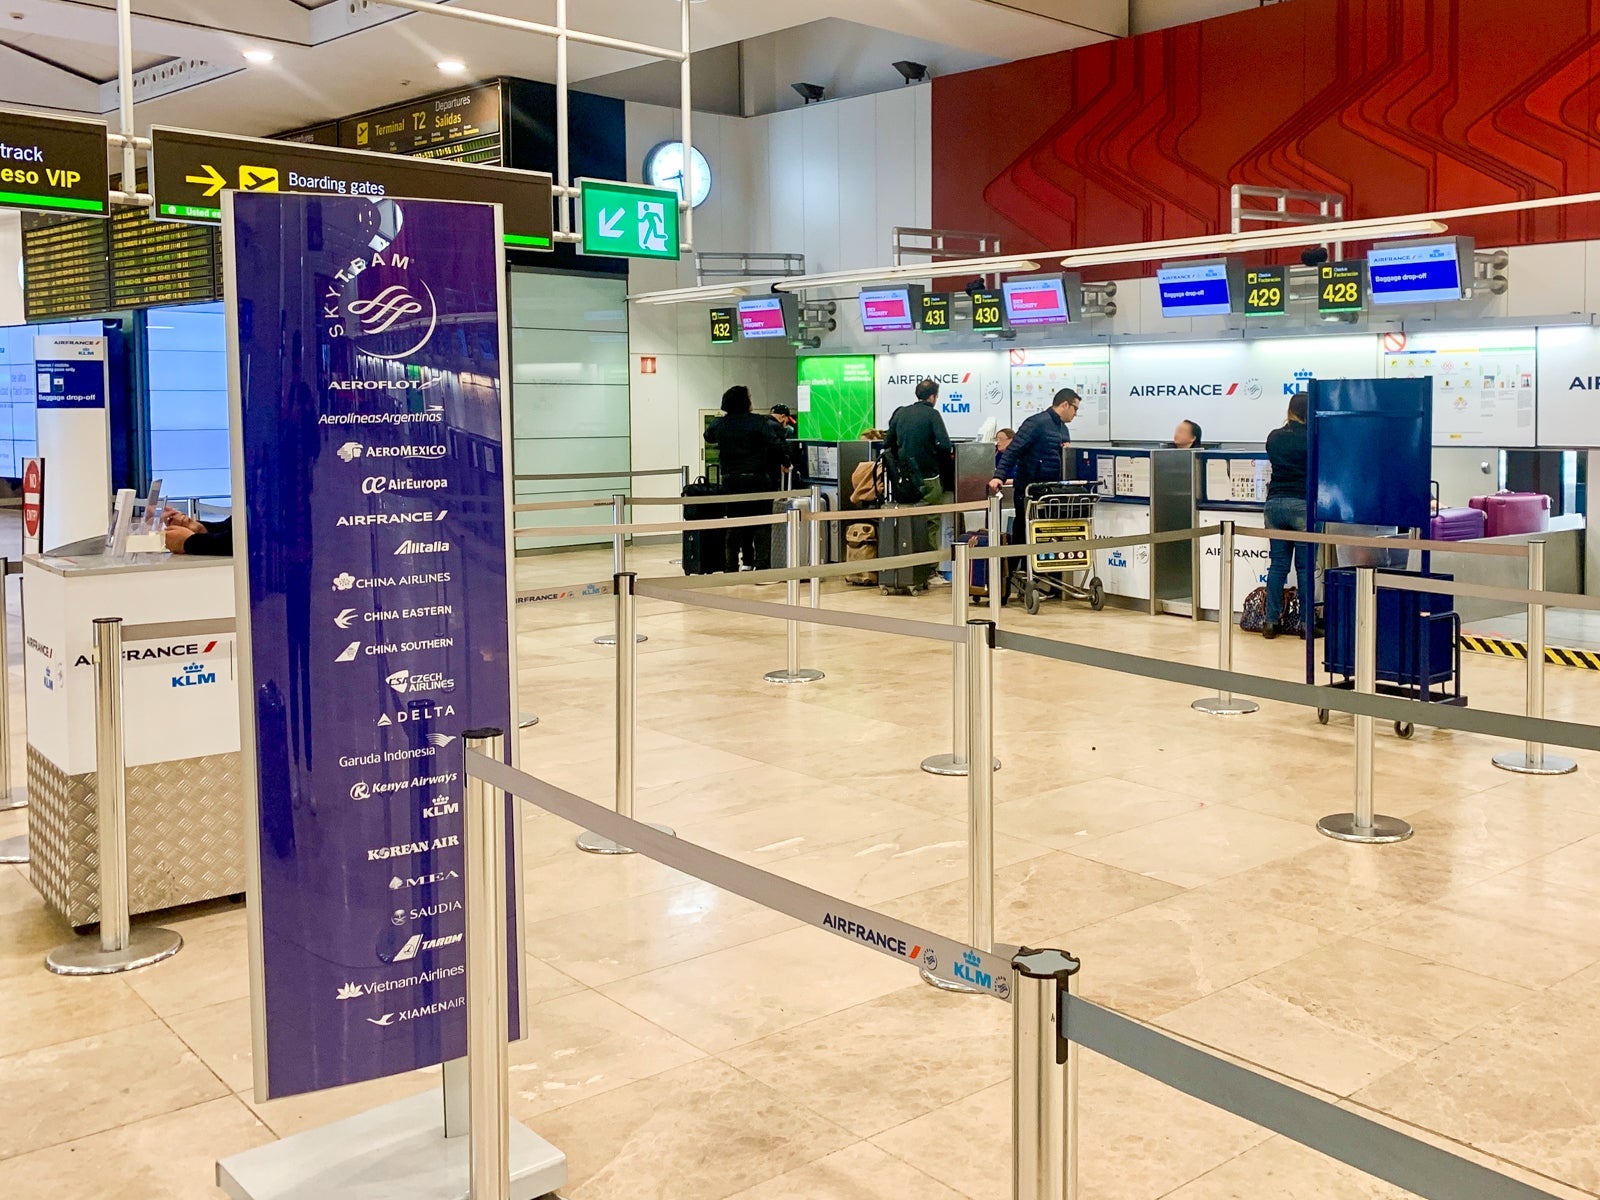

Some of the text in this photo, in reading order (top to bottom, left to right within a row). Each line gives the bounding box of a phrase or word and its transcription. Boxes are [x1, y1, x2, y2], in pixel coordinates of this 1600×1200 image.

[435, 95, 471, 112] Departures
[375, 111, 427, 136] Terminal T2
[435, 112, 462, 129] Salidas
[0, 143, 44, 162] track
[0, 167, 81, 188] eso VIP
[288, 171, 385, 196] Boarding gates
[186, 207, 210, 217] Usted
[1375, 272, 1427, 283] Baggage drop-off
[324, 252, 410, 338] SKYTEAM
[1248, 288, 1281, 307] 429
[1322, 283, 1358, 302] 428
[925, 310, 946, 325] 431
[975, 307, 999, 323] 430
[713, 323, 730, 337] 432
[328, 380, 420, 390] AEROFLOT
[887, 373, 959, 385] AIRFRANCE
[1129, 384, 1222, 397] AIRFRANCE
[942, 403, 971, 413] KLM
[29, 473, 37, 489] NO
[388, 478, 448, 490] AirEuropa
[336, 511, 433, 527] AIRFRANCE
[393, 539, 450, 555] Alitalia
[1108, 557, 1127, 568] KLM
[355, 572, 451, 589] CHINA AIRLINES
[515, 593, 558, 604] IRFRANCE
[364, 605, 452, 622] CHINA EASTERN
[74, 643, 199, 667] AIRANCE
[365, 638, 454, 656] CHINA SOUTHERN
[172, 672, 216, 688] KLM
[409, 672, 443, 684] CZECH
[409, 679, 455, 693] AIRLINES
[397, 704, 456, 723] DELTA
[339, 746, 436, 768] Garuda Indonesia
[372, 772, 458, 794] Kenya Airways
[423, 802, 459, 819] KLM
[367, 835, 460, 861] KOREAN AIR
[406, 870, 459, 888] MEA
[410, 900, 462, 920] SAUDIA
[421, 932, 463, 950] TAROM
[822, 912, 907, 956] AIRFRANCE
[364, 965, 465, 995] Vietnam Airlines
[953, 961, 992, 989] KLM
[399, 996, 466, 1022] XIAMENAIR
